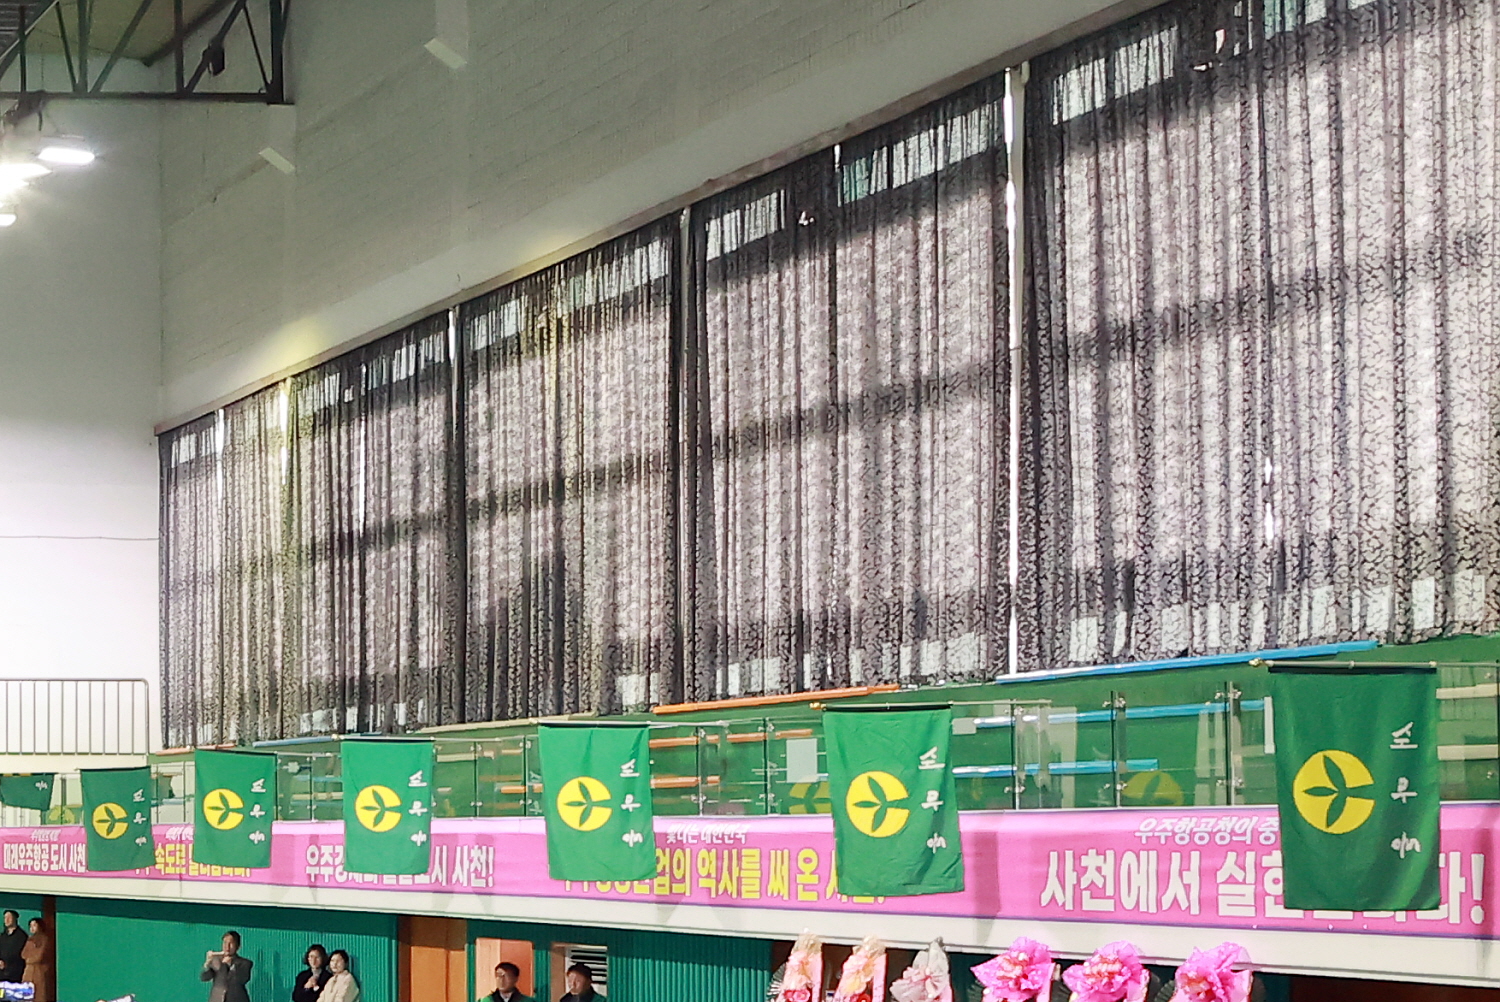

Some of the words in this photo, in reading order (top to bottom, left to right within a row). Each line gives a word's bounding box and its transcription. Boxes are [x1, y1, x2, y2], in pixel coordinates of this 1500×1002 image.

[1134, 816, 1256, 844] 우주항공청의
[50, 843, 68, 872] 도시
[452, 845, 496, 888] 사천!
[697, 848, 762, 900] 역사를
[768, 849, 791, 901] 써
[796, 848, 820, 902] 온
[1040, 848, 1200, 915] 사천에서
